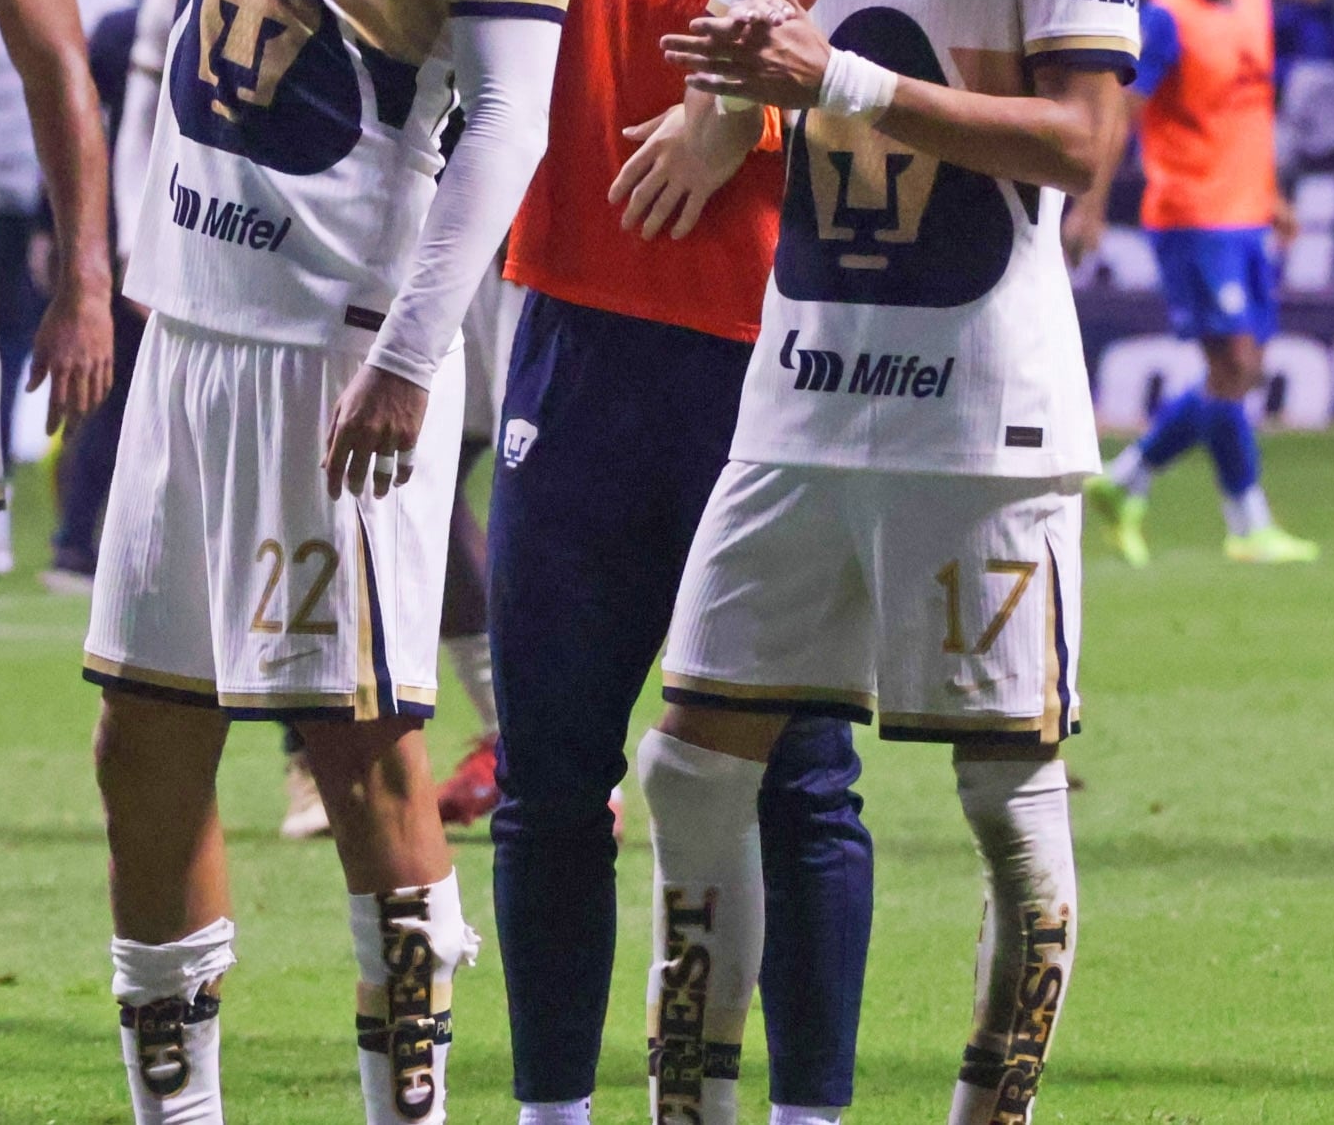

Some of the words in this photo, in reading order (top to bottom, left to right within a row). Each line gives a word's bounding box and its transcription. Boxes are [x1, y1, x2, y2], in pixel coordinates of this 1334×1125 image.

[202, 197, 292, 252] Mifel
[847, 353, 957, 399] Mifel
[249, 537, 341, 635] 22
[933, 559, 1039, 656] 17
[376, 886, 436, 1123] CREST
[987, 907, 1067, 1125] REST
